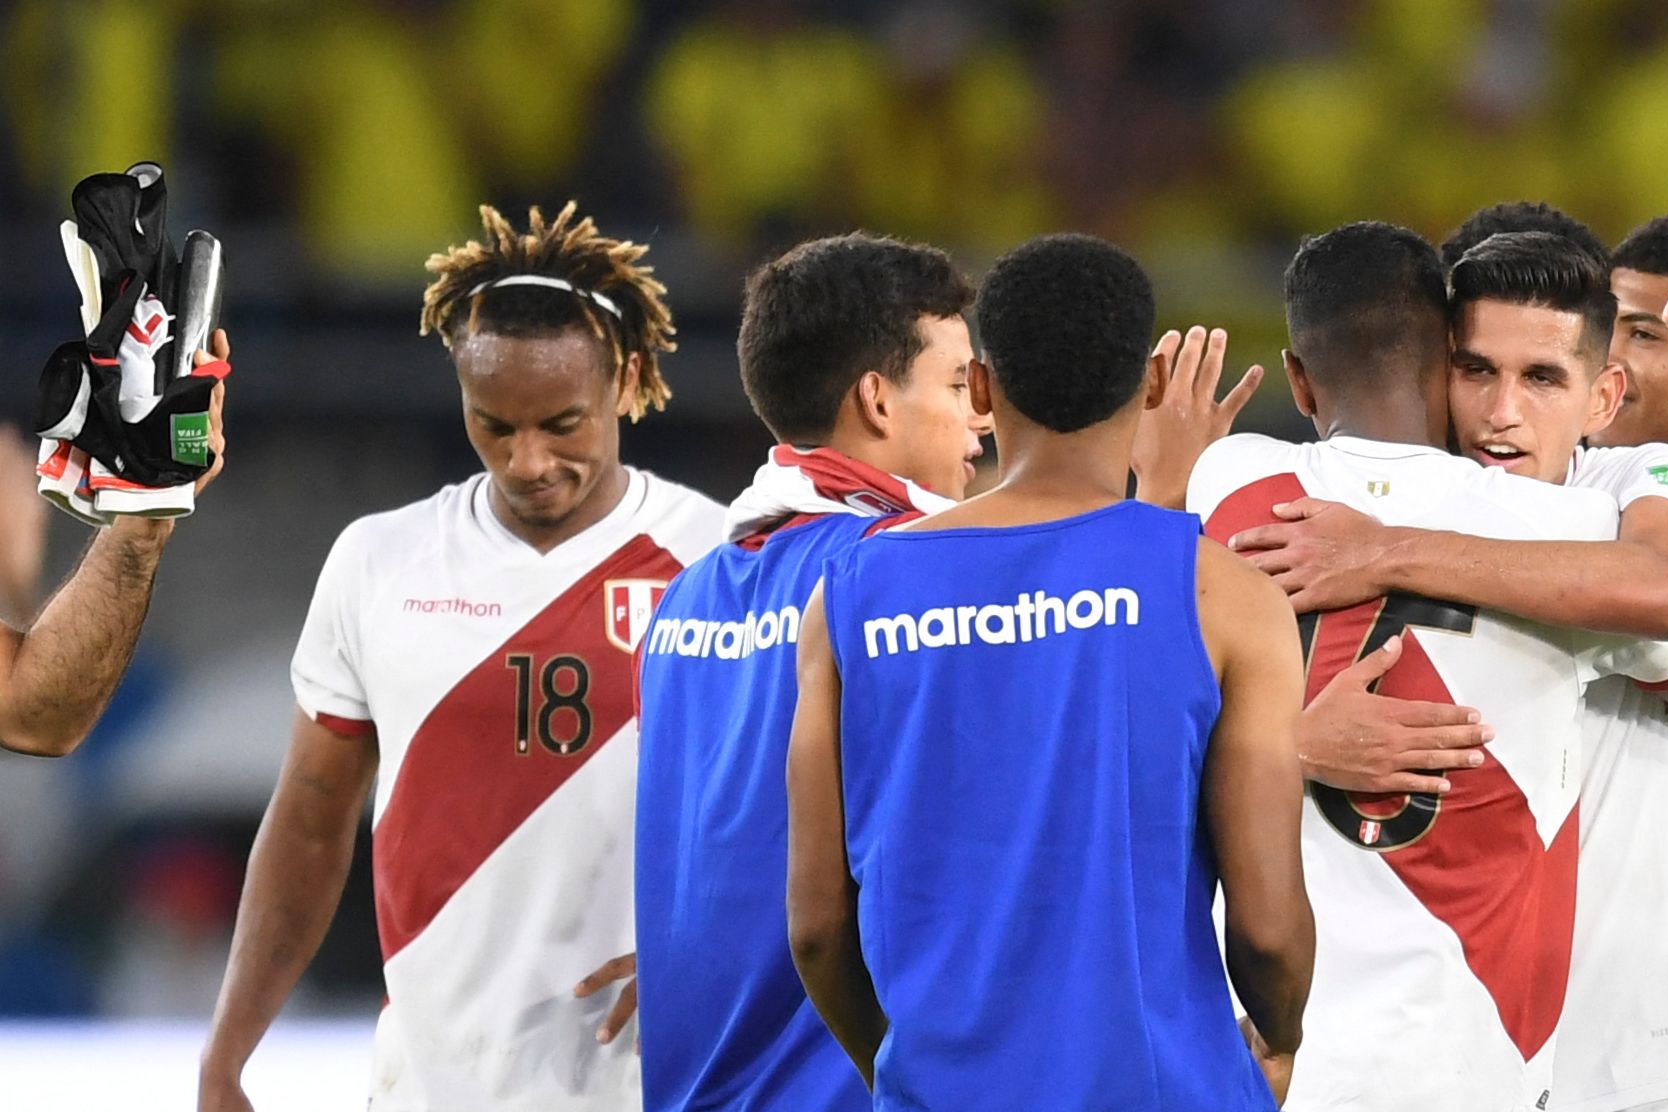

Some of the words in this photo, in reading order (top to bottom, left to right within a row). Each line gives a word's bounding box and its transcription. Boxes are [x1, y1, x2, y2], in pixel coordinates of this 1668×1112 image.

[403, 598, 501, 617] marathon
[864, 587, 1139, 658] marathon
[505, 653, 592, 756] 18
